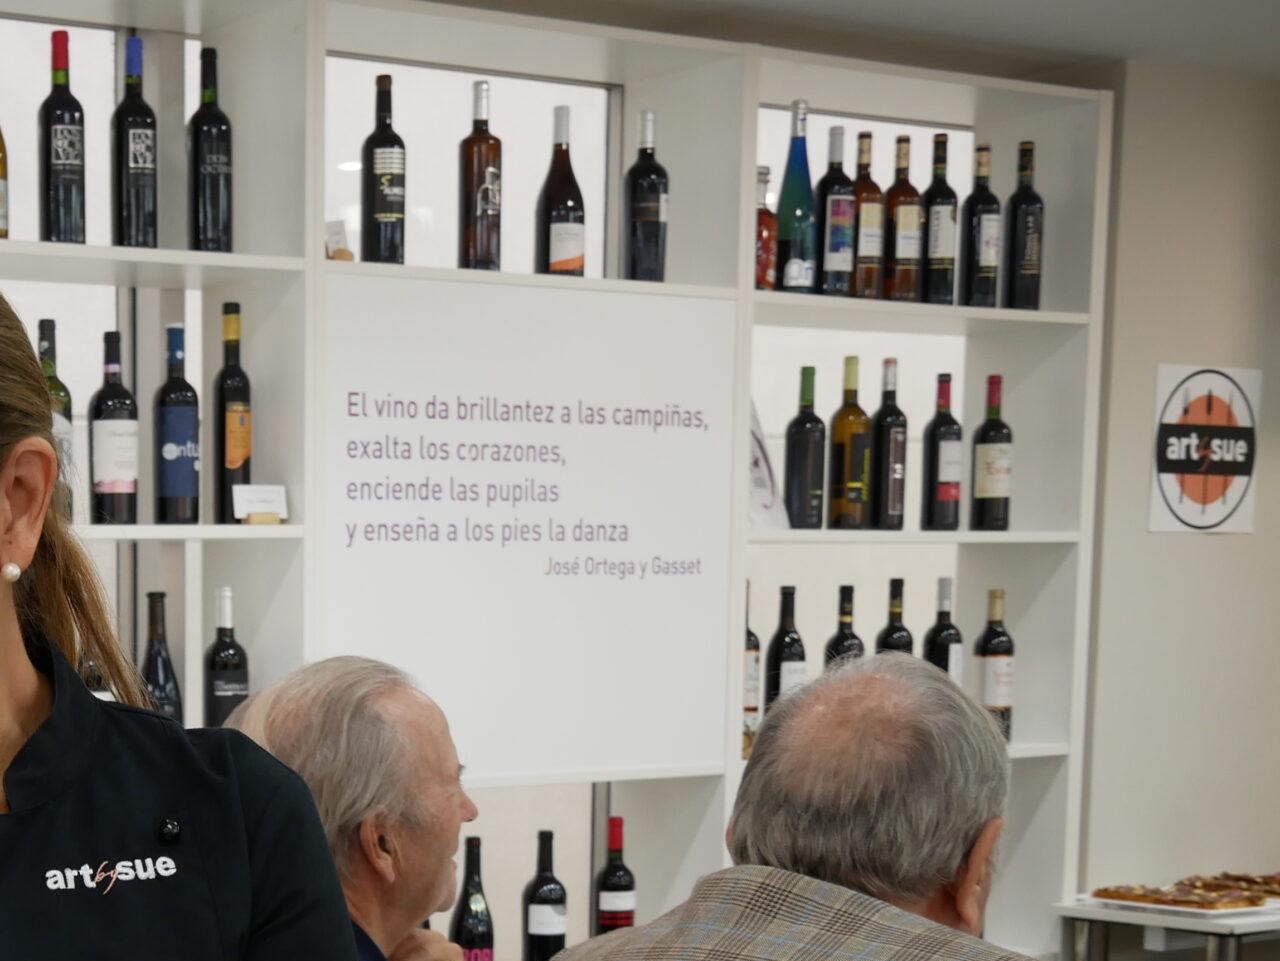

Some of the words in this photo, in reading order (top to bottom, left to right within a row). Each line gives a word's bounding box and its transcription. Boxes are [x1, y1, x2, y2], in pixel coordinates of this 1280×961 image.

[348, 392, 367, 417] El
[375, 393, 418, 419] vino
[425, 395, 449, 420] da
[457, 396, 554, 423] brillantez
[561, 406, 571, 424] a
[578, 401, 606, 425] las
[612, 405, 708, 432] campiñas,
[347, 435, 411, 459] exalta
[420, 436, 449, 460] los
[457, 443, 566, 466] corazones,
[347, 476, 442, 501] enciende
[450, 477, 479, 501] las
[487, 478, 560, 508] pupilas
[346, 524, 357, 548] y
[364, 517, 439, 541] enseña
[447, 524, 457, 541] a
[465, 518, 494, 541] los
[501, 518, 542, 548] pies
[549, 518, 565, 541] la
[573, 519, 628, 542] danza
[544, 556, 580, 576] José
[585, 556, 635, 580] Ortega
[639, 562, 648, 579] y
[652, 556, 701, 575] Gasset
